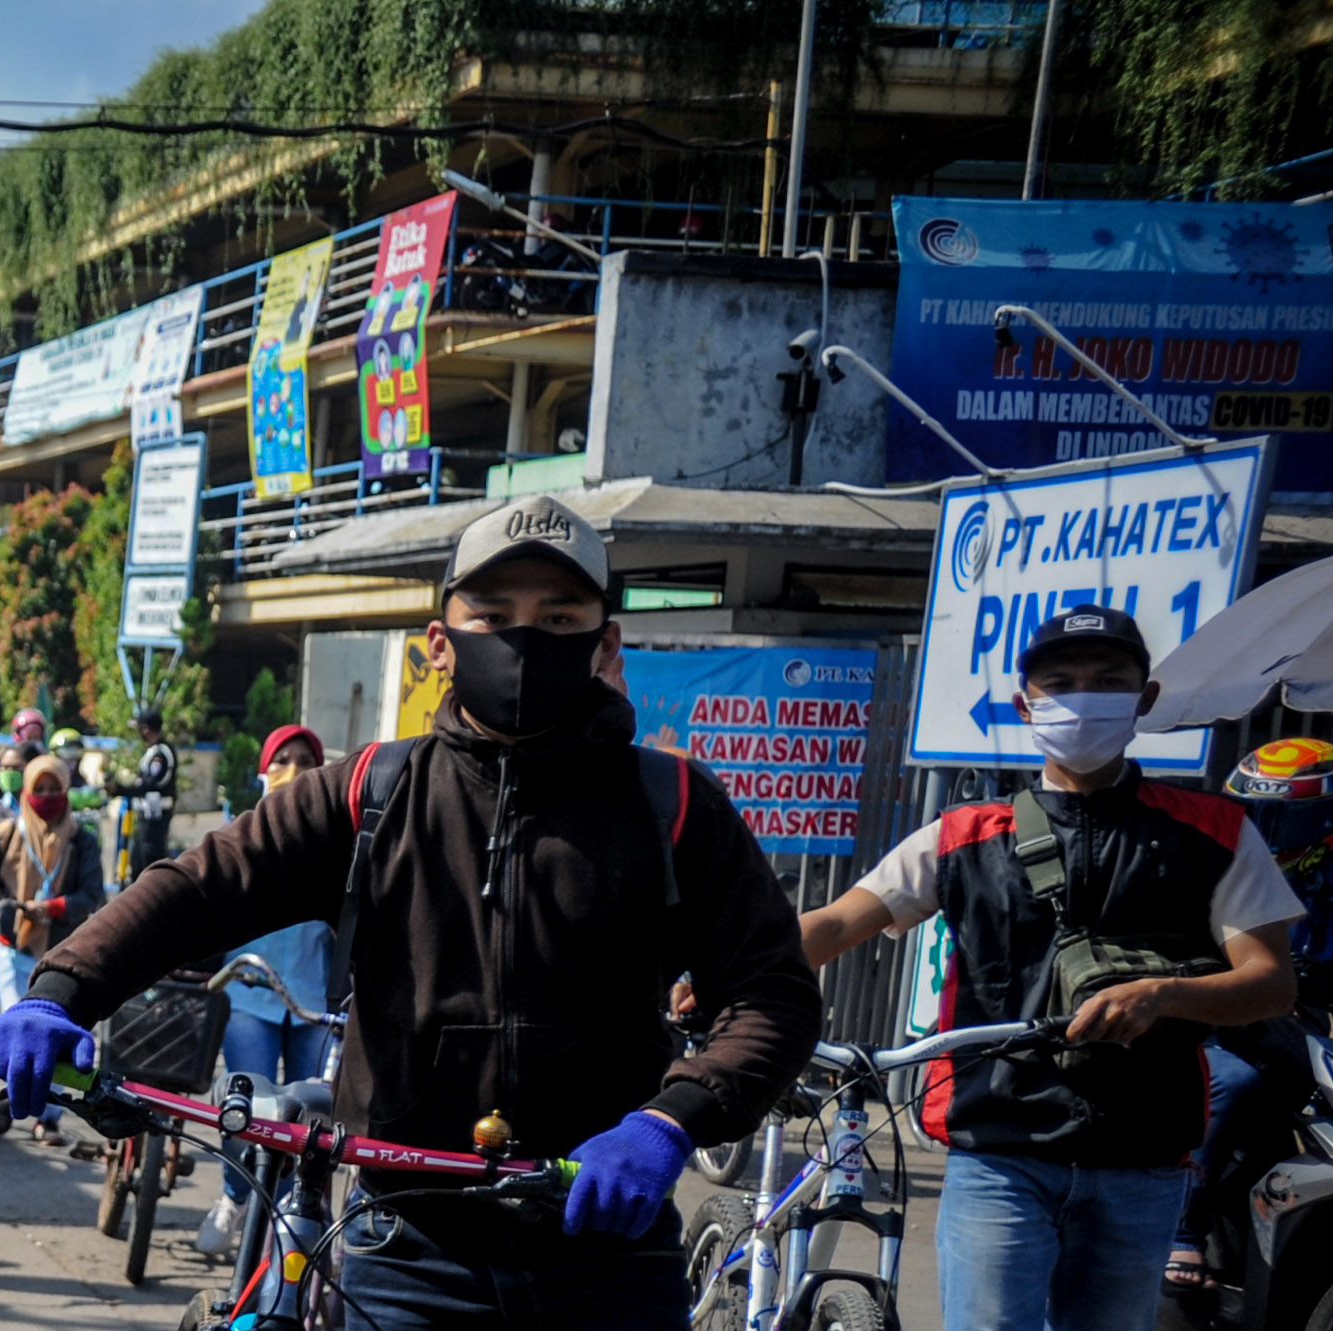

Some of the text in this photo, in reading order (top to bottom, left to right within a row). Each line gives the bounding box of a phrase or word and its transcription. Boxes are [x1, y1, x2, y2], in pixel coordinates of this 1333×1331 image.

[919, 298, 944, 324] PT
[1033, 301, 1154, 329] MENDUKUNG
[1155, 303, 1270, 331] KEPUTUSAN
[1031, 336, 1062, 381] H.
[1067, 336, 1153, 383] JOKO
[1160, 338, 1301, 385] WIDODO
[956, 390, 1330, 427] DALAM MEMBERANTAS COVID-19
[1056, 430, 1083, 461] DI
[689, 695, 770, 726] ANDA
[689, 732, 831, 764] KAWASAN
[741, 809, 858, 838] MASKER
[379, 1148, 424, 1164] FLAT
